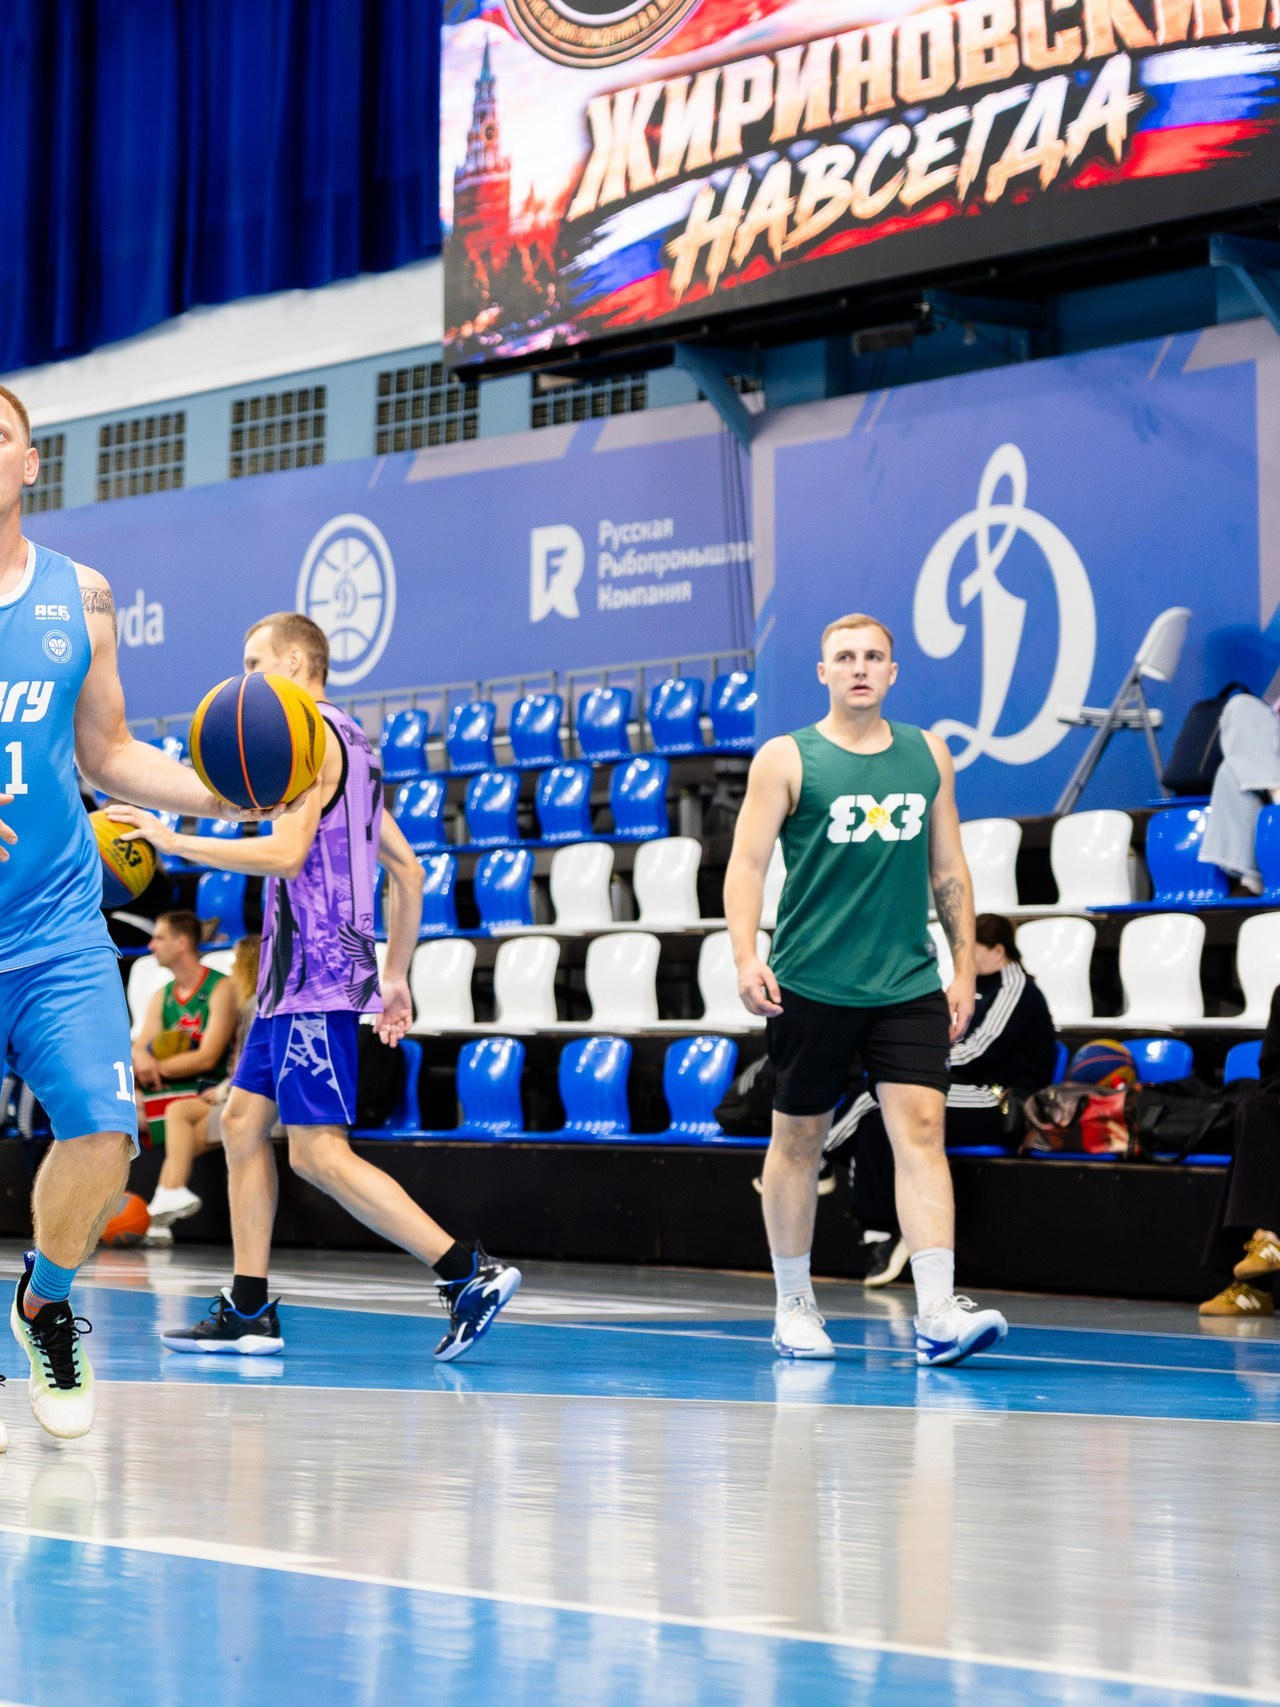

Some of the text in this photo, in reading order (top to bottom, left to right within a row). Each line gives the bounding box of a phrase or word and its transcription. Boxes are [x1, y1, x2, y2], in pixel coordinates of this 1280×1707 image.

[567, 0, 1280, 222] ЖИРИНОВСКИ
[665, 52, 1144, 302] НАВСЕГДА
[597, 579, 692, 612] Компания
[598, 517, 675, 551] Русская
